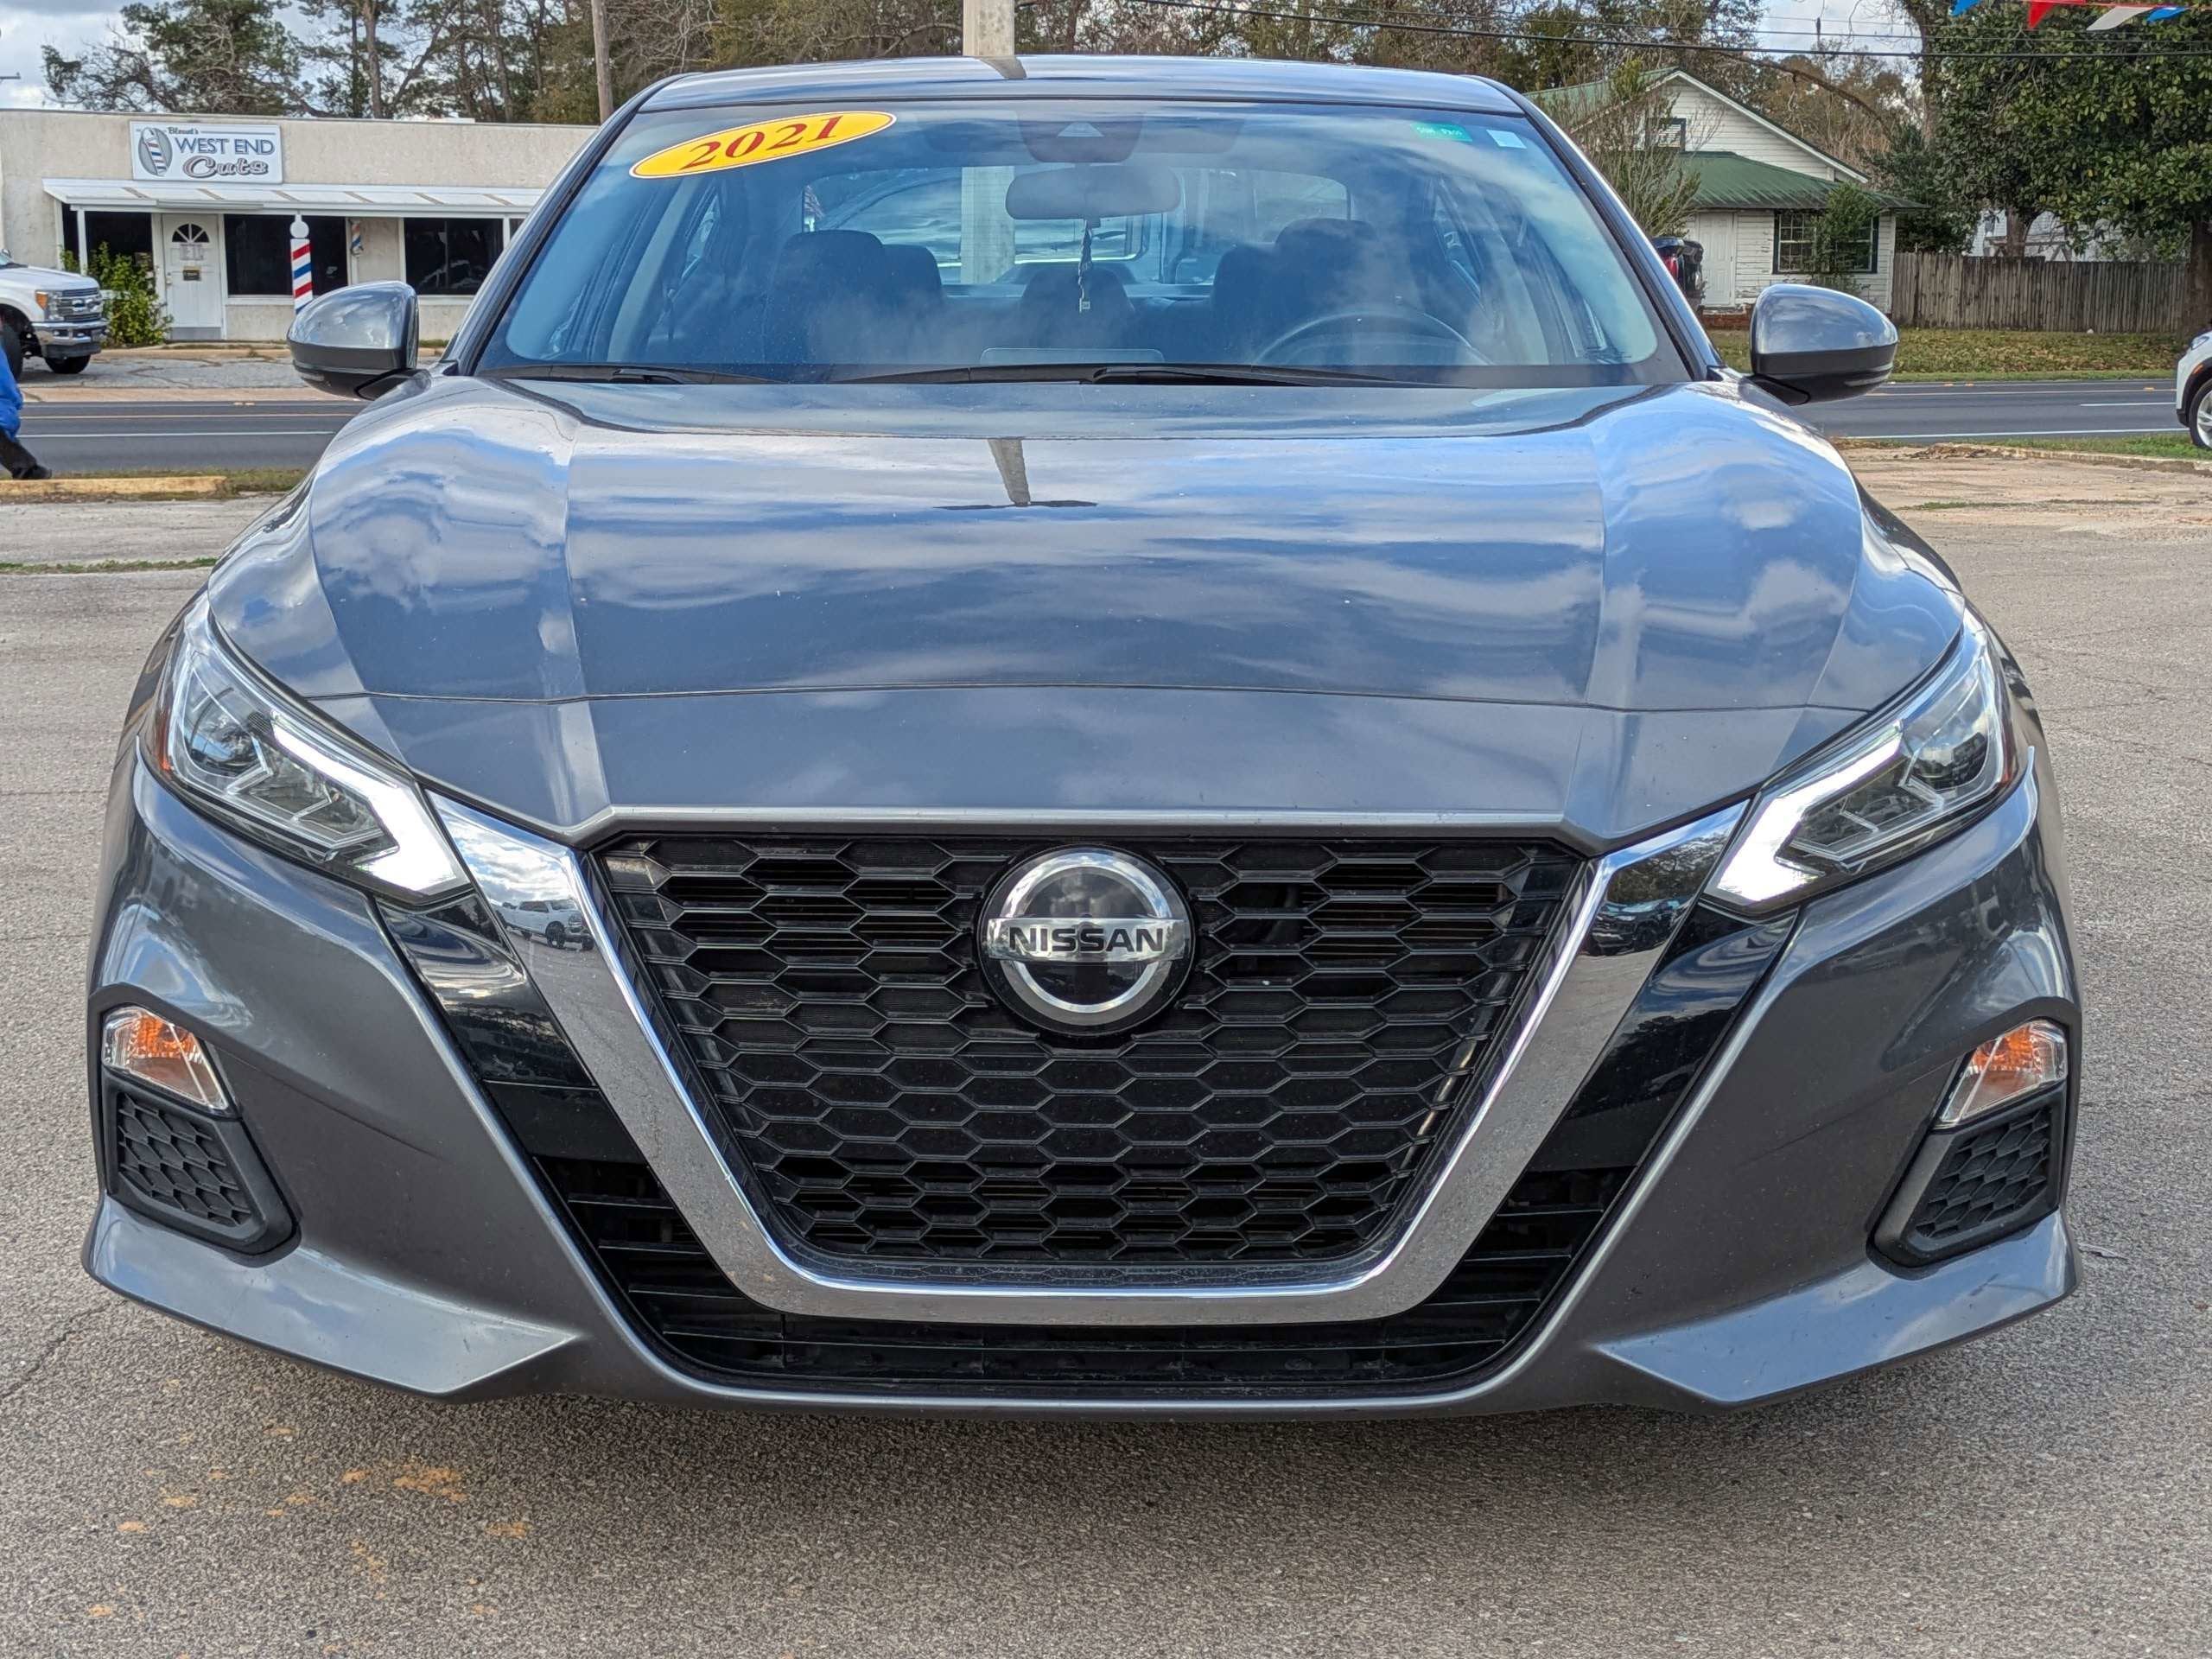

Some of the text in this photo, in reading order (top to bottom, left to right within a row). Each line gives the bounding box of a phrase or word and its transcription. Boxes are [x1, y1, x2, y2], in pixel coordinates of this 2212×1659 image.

[175, 137, 276, 156] WEST END
[678, 115, 843, 170] 2021
[182, 156, 269, 179] Cuts
[1008, 926, 1164, 952] NISSAN
